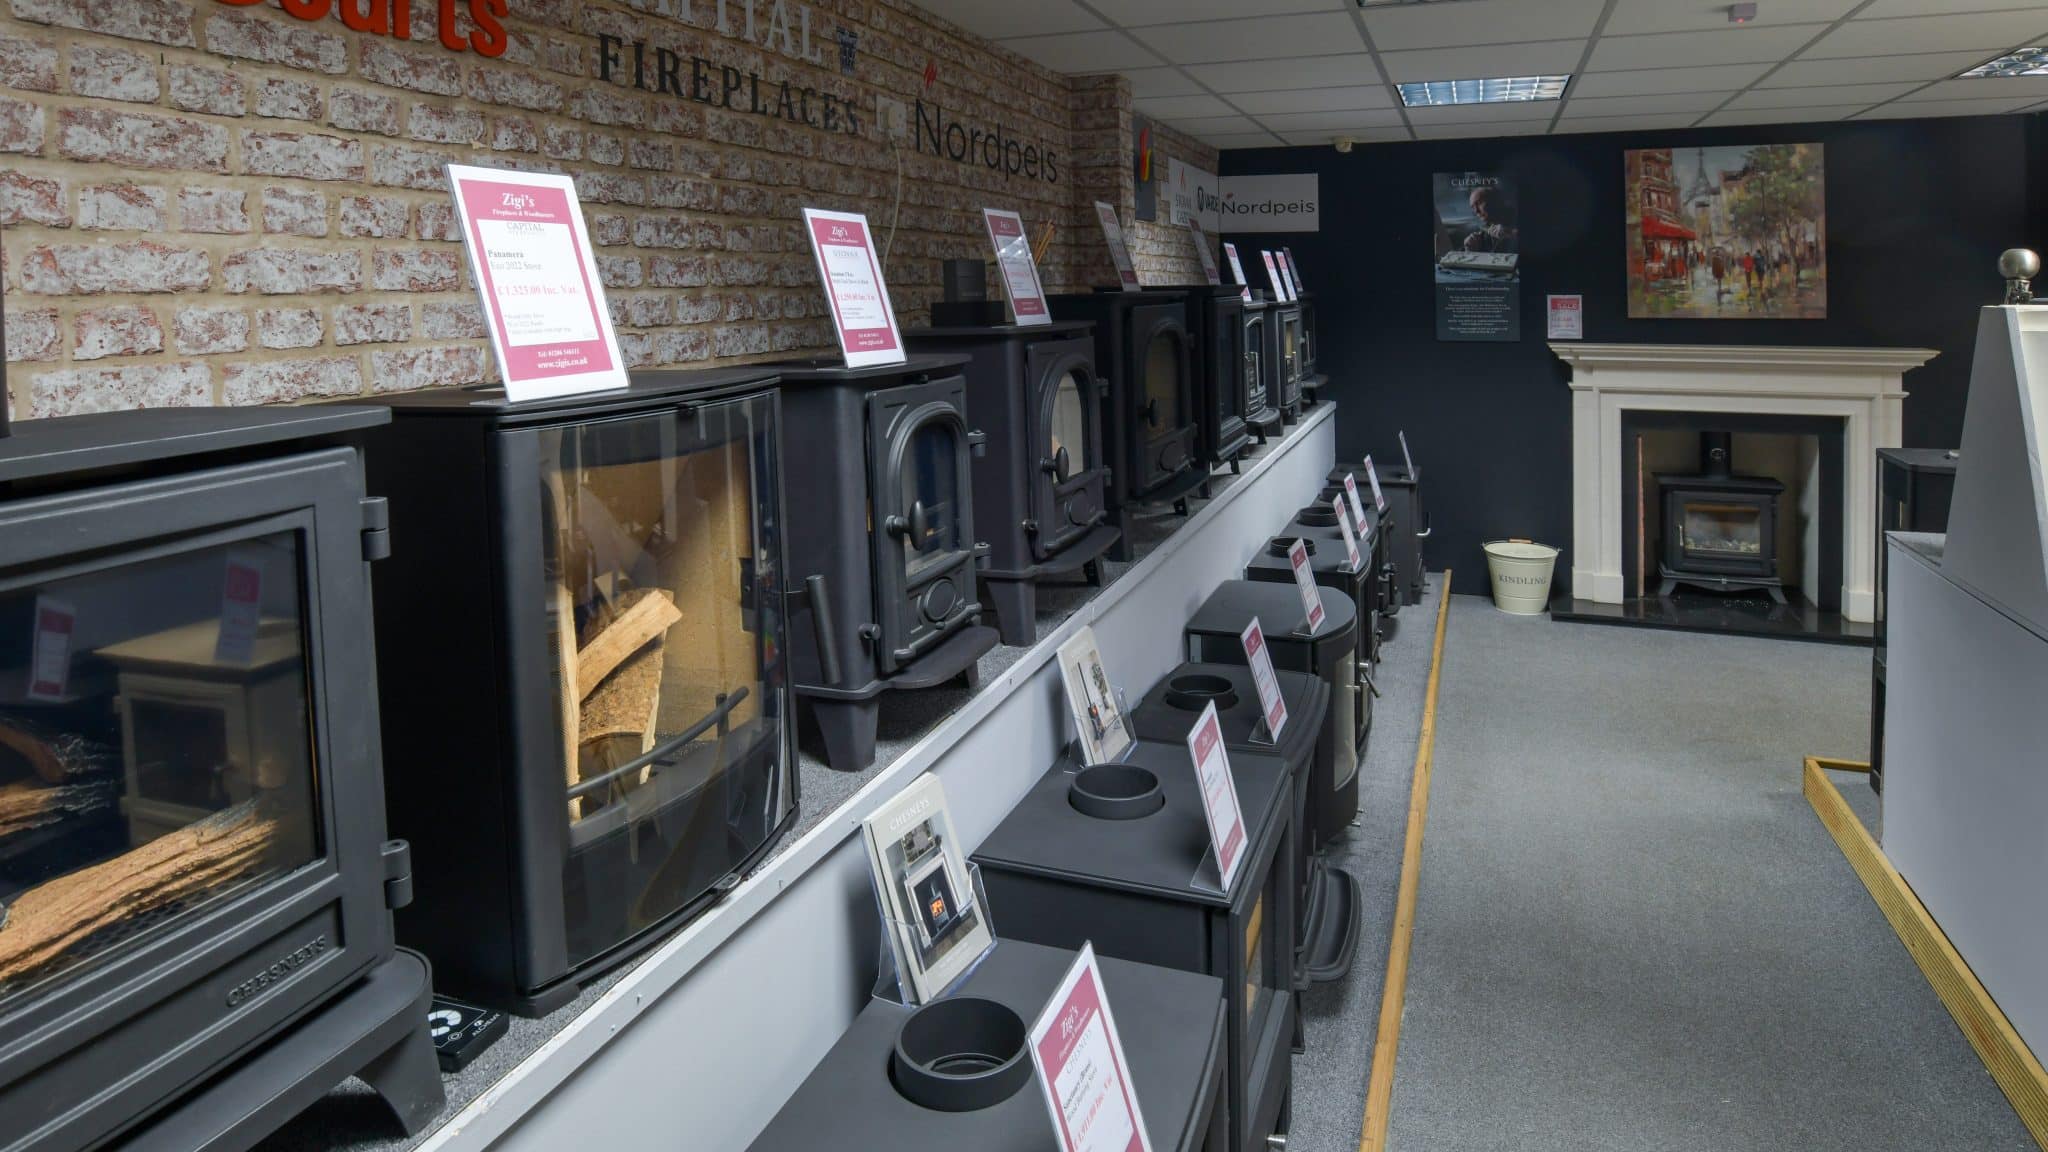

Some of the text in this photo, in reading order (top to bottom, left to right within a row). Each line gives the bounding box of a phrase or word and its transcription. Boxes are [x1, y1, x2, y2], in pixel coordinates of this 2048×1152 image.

[598, 33, 858, 135] FIREPLACES
[915, 98, 1058, 184] Nordpeis
[502, 192, 536, 210] Zigi's
[1221, 200, 1316, 217] Nordpeis
[1498, 573, 1547, 586] KINDLING
